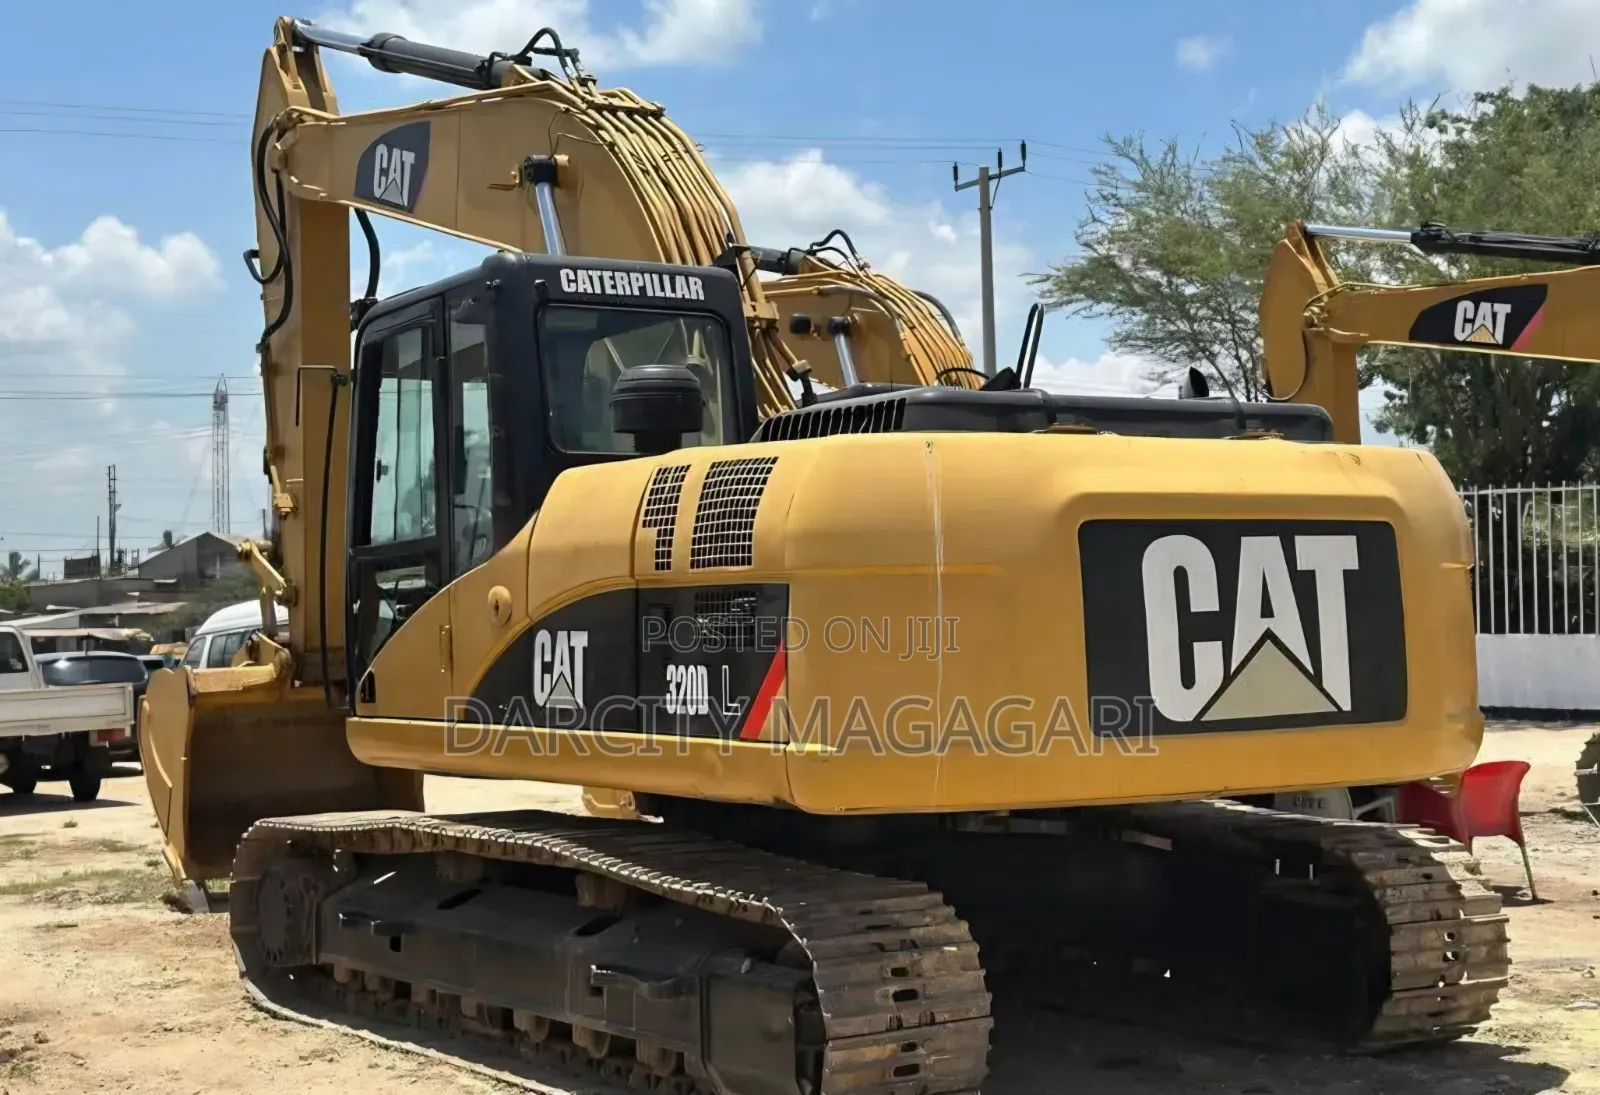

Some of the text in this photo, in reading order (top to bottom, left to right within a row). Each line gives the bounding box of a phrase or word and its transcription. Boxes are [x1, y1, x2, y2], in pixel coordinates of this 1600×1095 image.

[373, 143, 416, 206] CAT
[559, 268, 705, 301] CATERPILLAR
[1453, 300, 1512, 345] CAT
[1142, 534, 1359, 722] CAT
[533, 629, 588, 710] CAT
[666, 664, 741, 716] 320D L
